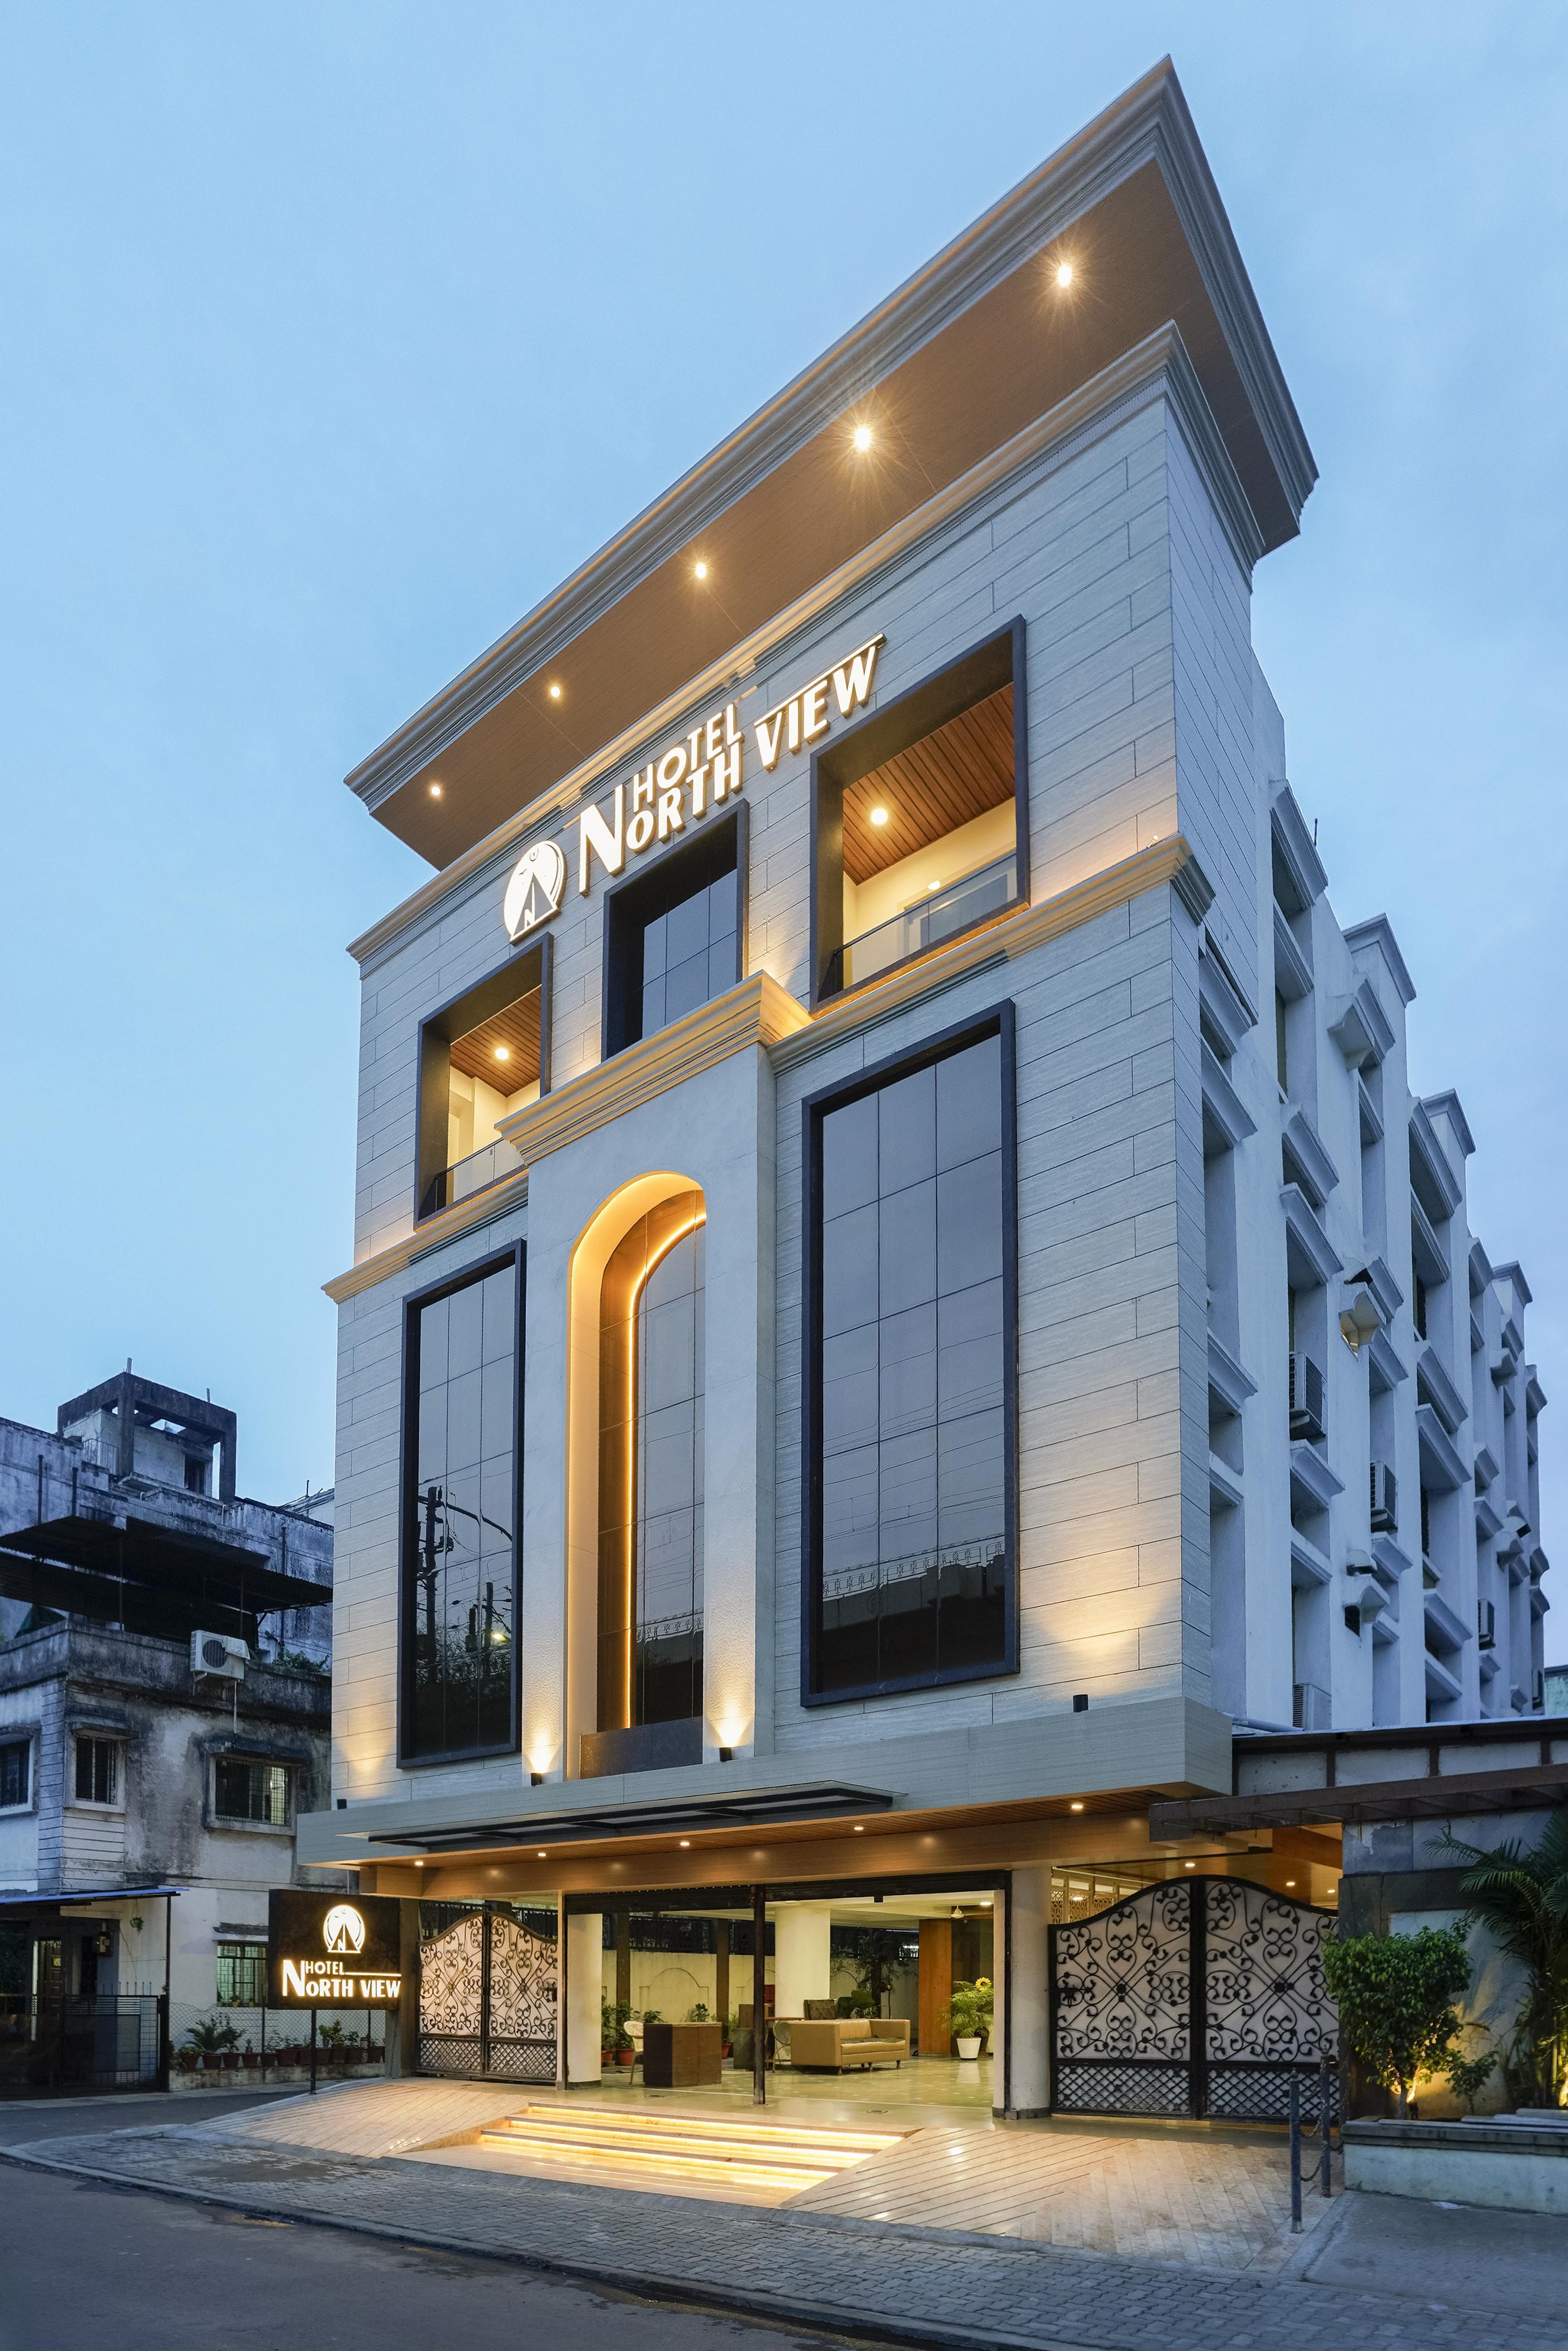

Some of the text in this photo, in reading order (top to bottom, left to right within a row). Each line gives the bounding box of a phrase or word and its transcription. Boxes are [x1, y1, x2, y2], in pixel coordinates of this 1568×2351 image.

[578, 645, 876, 894] NORTH VIEW
[633, 703, 742, 813] HOTEL
[282, 1960, 401, 1998] NORTH VIEW
[305, 1960, 345, 1975] HOTEL
